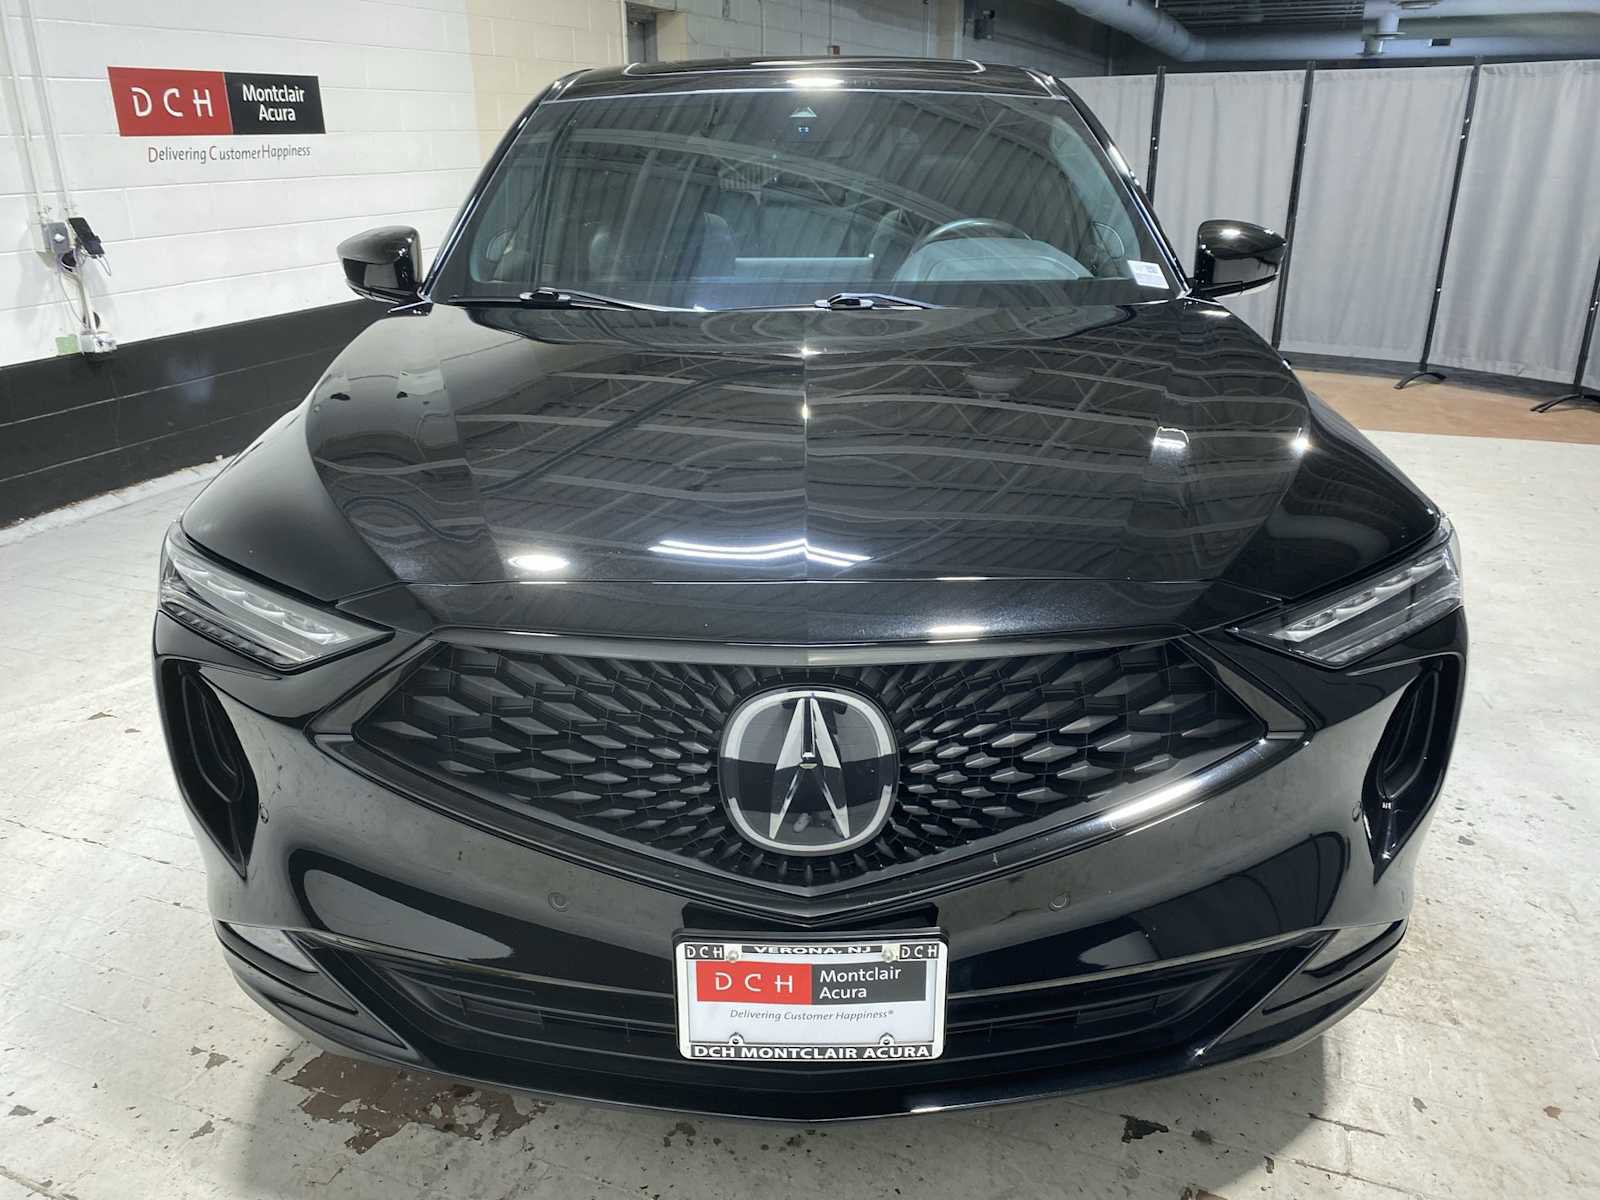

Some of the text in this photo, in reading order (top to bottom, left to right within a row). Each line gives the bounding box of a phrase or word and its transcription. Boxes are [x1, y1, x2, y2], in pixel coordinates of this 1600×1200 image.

[242, 84, 305, 103] Montclair
[130, 86, 214, 118] DCH
[258, 104, 296, 121] Acura
[148, 147, 207, 164] Delivering
[686, 946, 725, 959] DCH
[847, 945, 872, 954] NJ
[901, 945, 938, 959] DCH
[714, 972, 793, 993] DCH
[819, 967, 902, 983] Montclair
[819, 986, 867, 1000] Acura
[730, 1009, 781, 1021] Delivering
[784, 1011, 833, 1021] Customer
[694, 1045, 929, 1060] DCH MONTCLAIR ACURA
